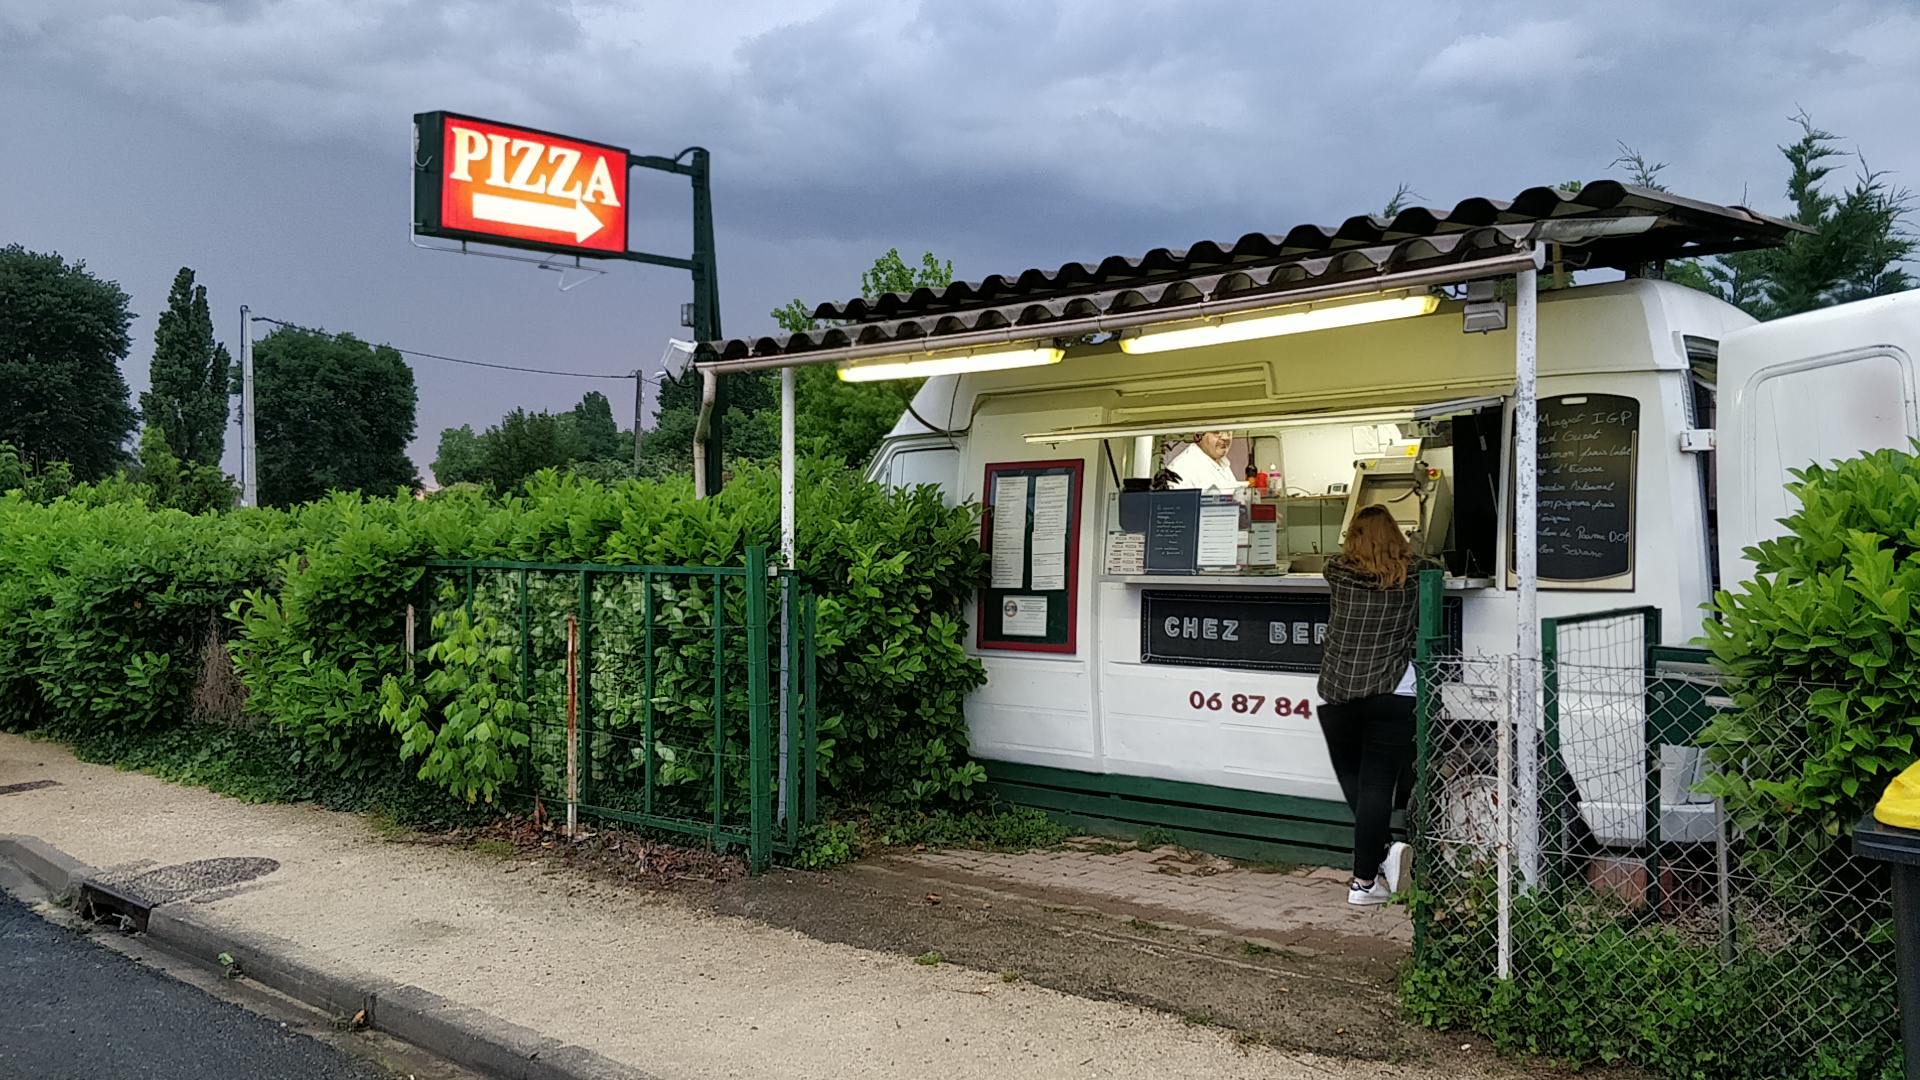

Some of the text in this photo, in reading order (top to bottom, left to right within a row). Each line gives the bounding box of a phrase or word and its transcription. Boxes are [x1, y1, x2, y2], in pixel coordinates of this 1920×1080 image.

[450, 127, 621, 207] PIZZA
[1591, 411, 1633, 426] IGP
[1164, 616, 1240, 641] CHEZ
[1189, 690, 1312, 720] 06 87 84
